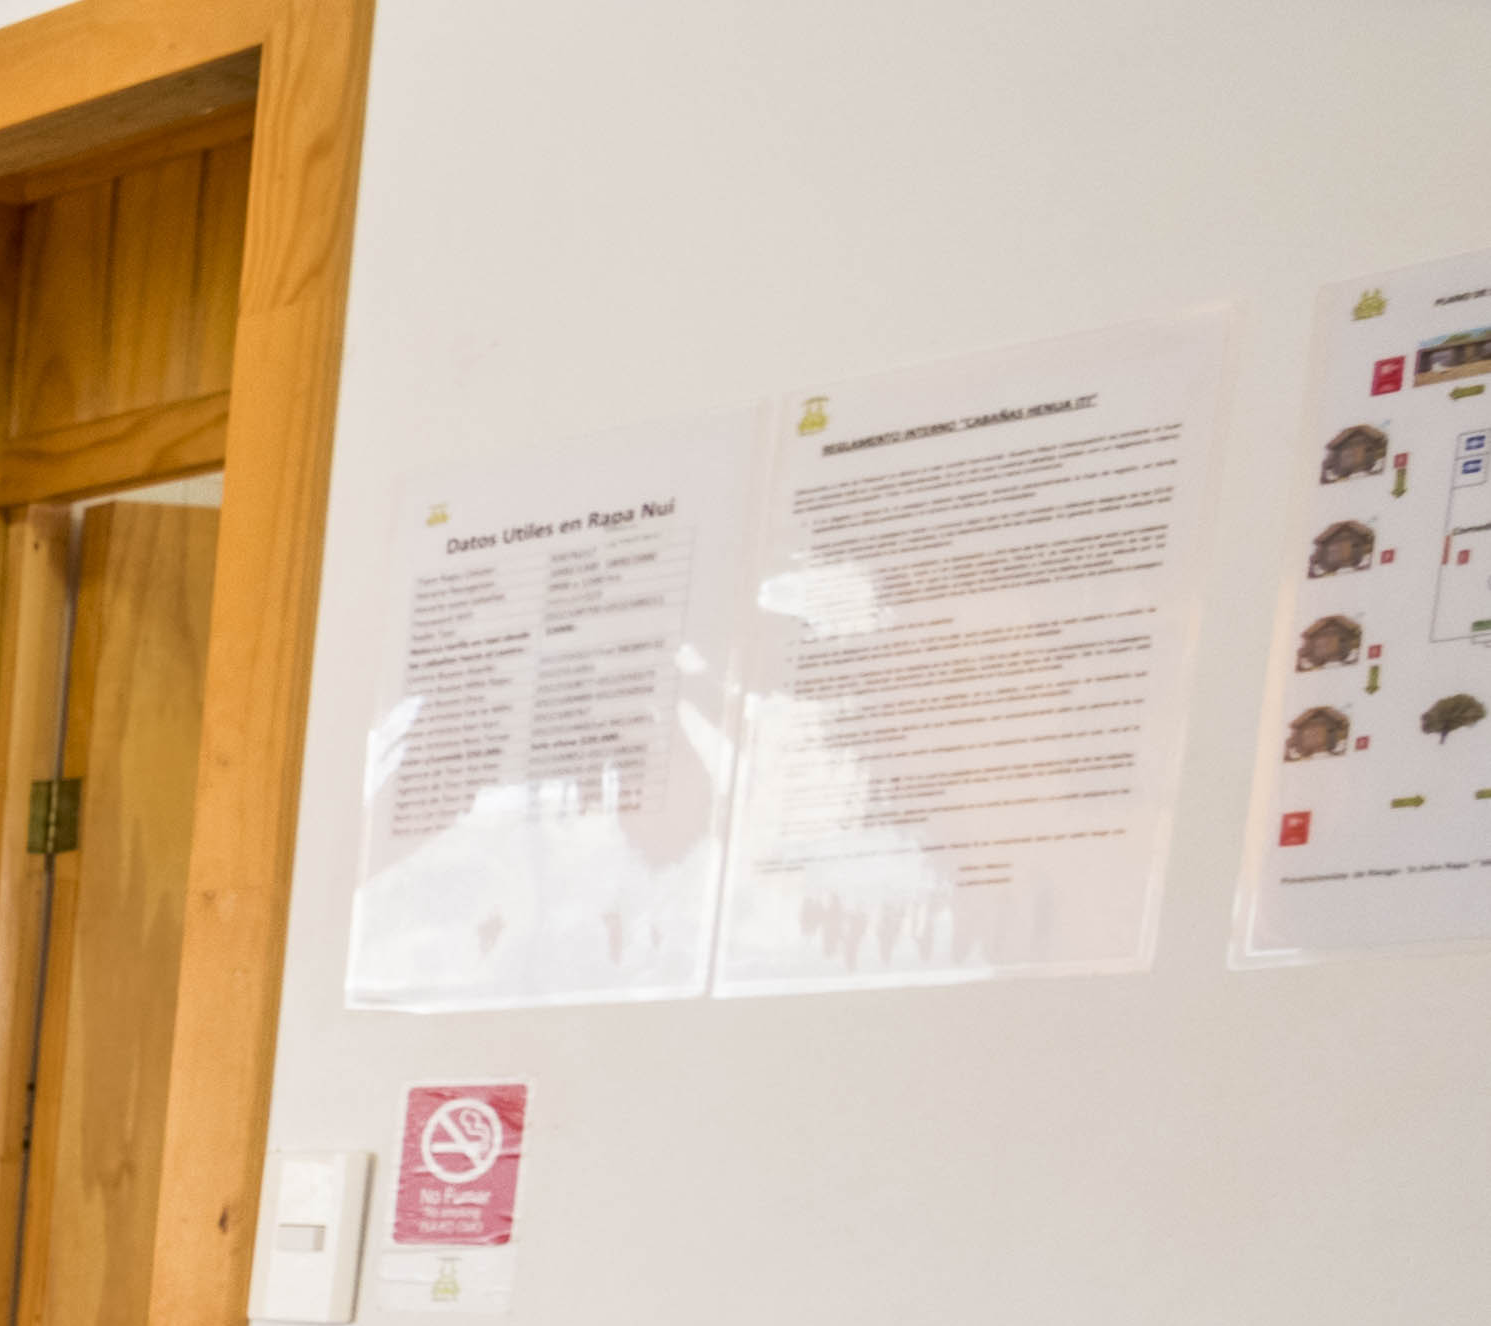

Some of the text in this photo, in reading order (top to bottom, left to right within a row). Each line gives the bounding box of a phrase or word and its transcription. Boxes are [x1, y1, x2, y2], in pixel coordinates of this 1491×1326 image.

[446, 497, 676, 555] Datos Utiles en Rapa Nui
[419, 1187, 441, 1205] No
